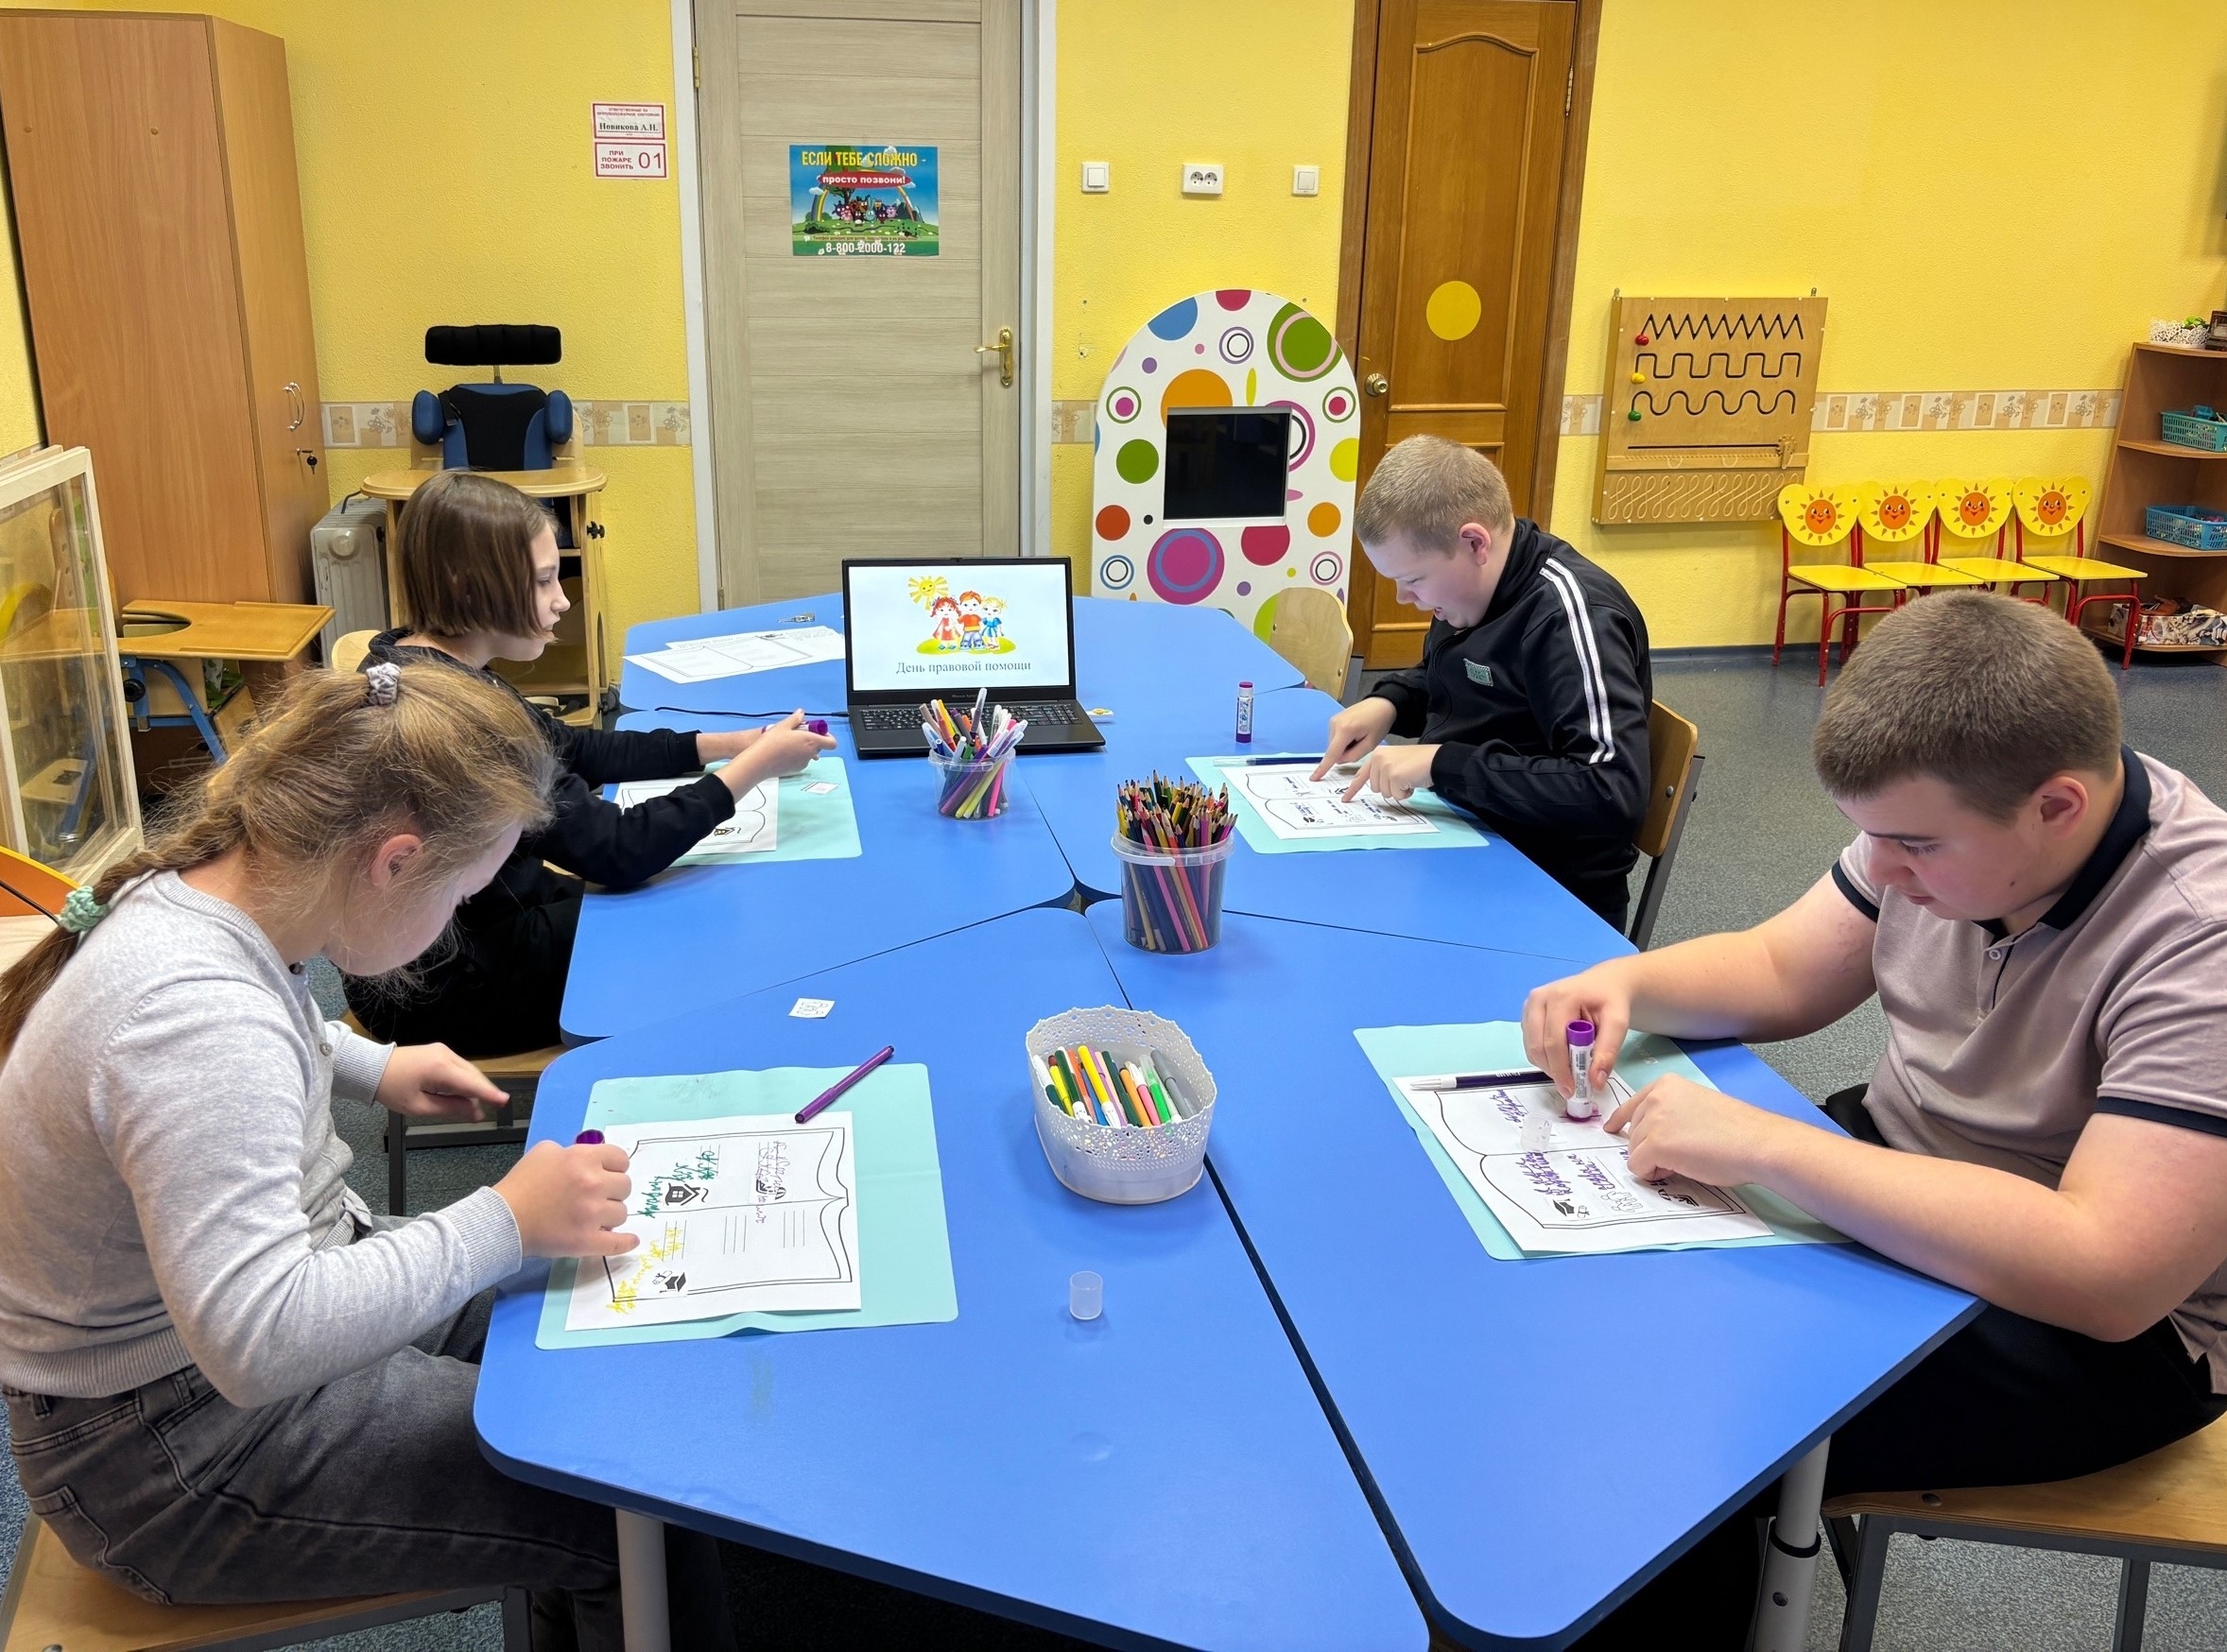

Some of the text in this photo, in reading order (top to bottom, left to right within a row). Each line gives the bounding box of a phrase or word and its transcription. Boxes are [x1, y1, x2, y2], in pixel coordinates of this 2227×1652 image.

[638, 151, 662, 169] 01
[802, 151, 833, 166] ЕСЛИ
[836, 151, 863, 166] ТЕБЕ
[866, 152, 918, 167] СЛОЖНО
[822, 176, 906, 184] просто позвони!
[825, 242, 906, 253] 8-800-2000-122
[896, 661, 1031, 675] День правовой помощи
